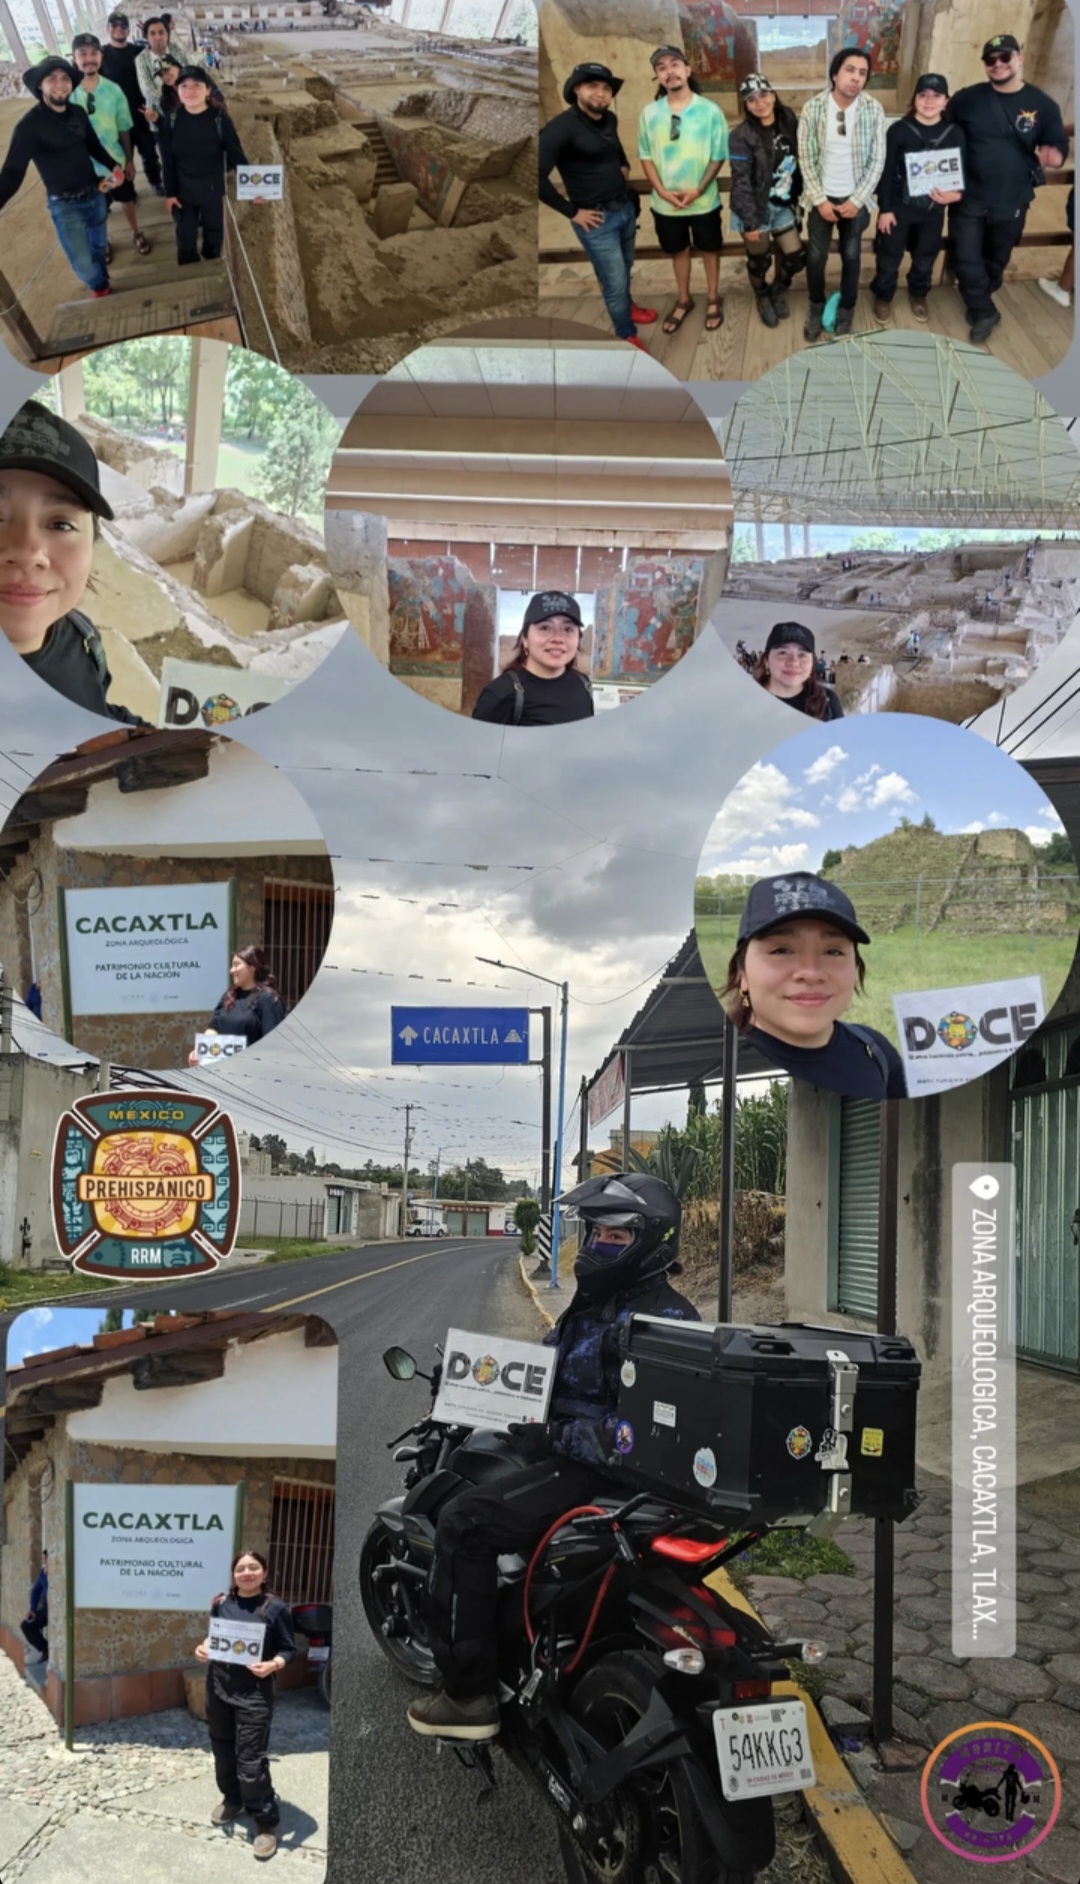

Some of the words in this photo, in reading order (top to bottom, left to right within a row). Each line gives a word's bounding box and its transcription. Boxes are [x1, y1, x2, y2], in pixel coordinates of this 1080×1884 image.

[75, 912, 219, 935] CACAXTLA
[105, 939, 127, 947] ZONA
[95, 962, 151, 972] PATRIMONIO
[153, 961, 200, 970] CULTURAL
[115, 972, 128, 981] DE
[129, 972, 142, 980] LA
[423, 1026, 499, 1045] CACAXTLA
[82, 1511, 224, 1531] CACAXTLA
[100, 1558, 156, 1567] PATRIMONIO
[157, 1560, 204, 1569] CULTURAL
[119, 1568, 132, 1576] DE
[134, 1568, 145, 1576] LA
[729, 1727, 804, 1772] 54KKG3
